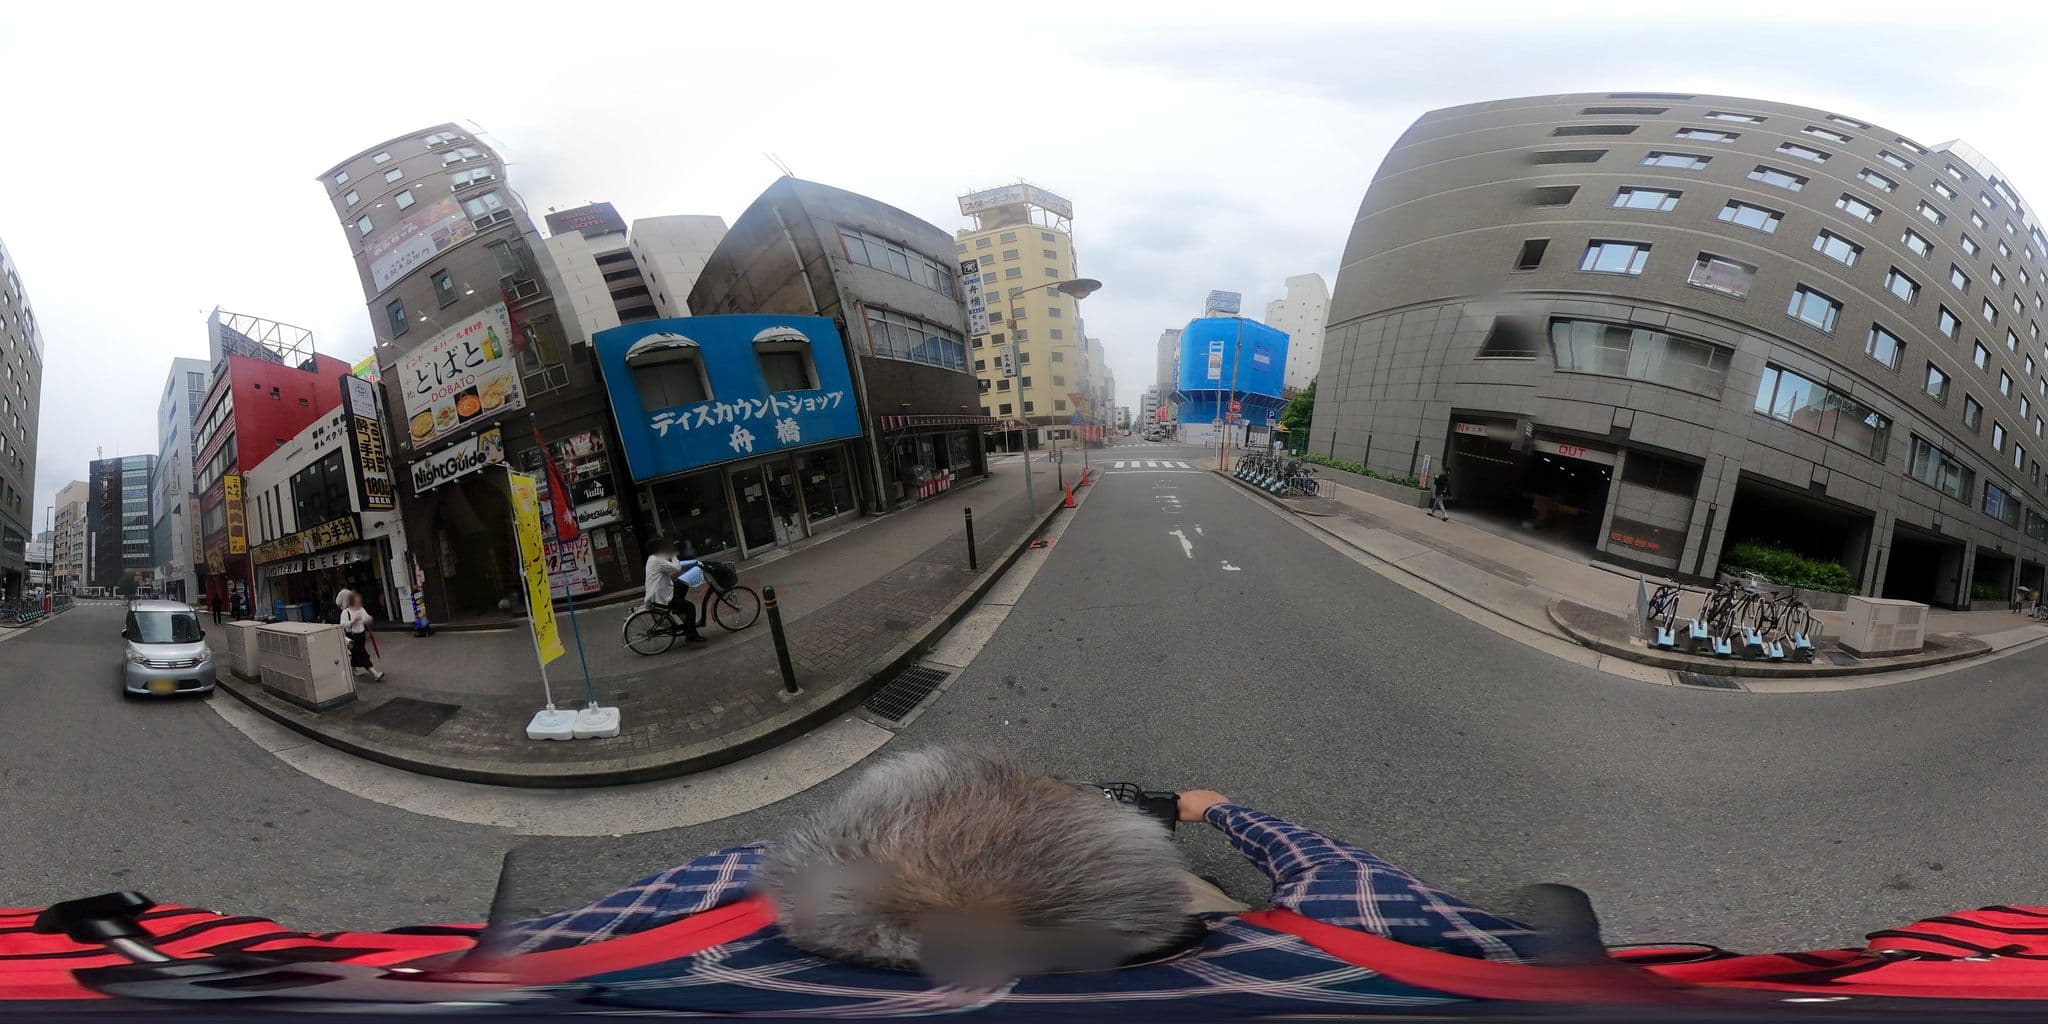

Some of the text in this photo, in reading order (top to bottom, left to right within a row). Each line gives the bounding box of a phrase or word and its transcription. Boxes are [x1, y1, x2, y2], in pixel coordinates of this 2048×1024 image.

[415, 341, 485, 394] どばと
[430, 373, 476, 402] DOBATO
[650, 391, 844, 437] ディスカウントショップ
[371, 422, 387, 473] YOTTEBA
[1558, 444, 1586, 458] OUT
[414, 450, 487, 489] NightGuide
[369, 496, 391, 504] BEER
[308, 551, 351, 570] BEER
